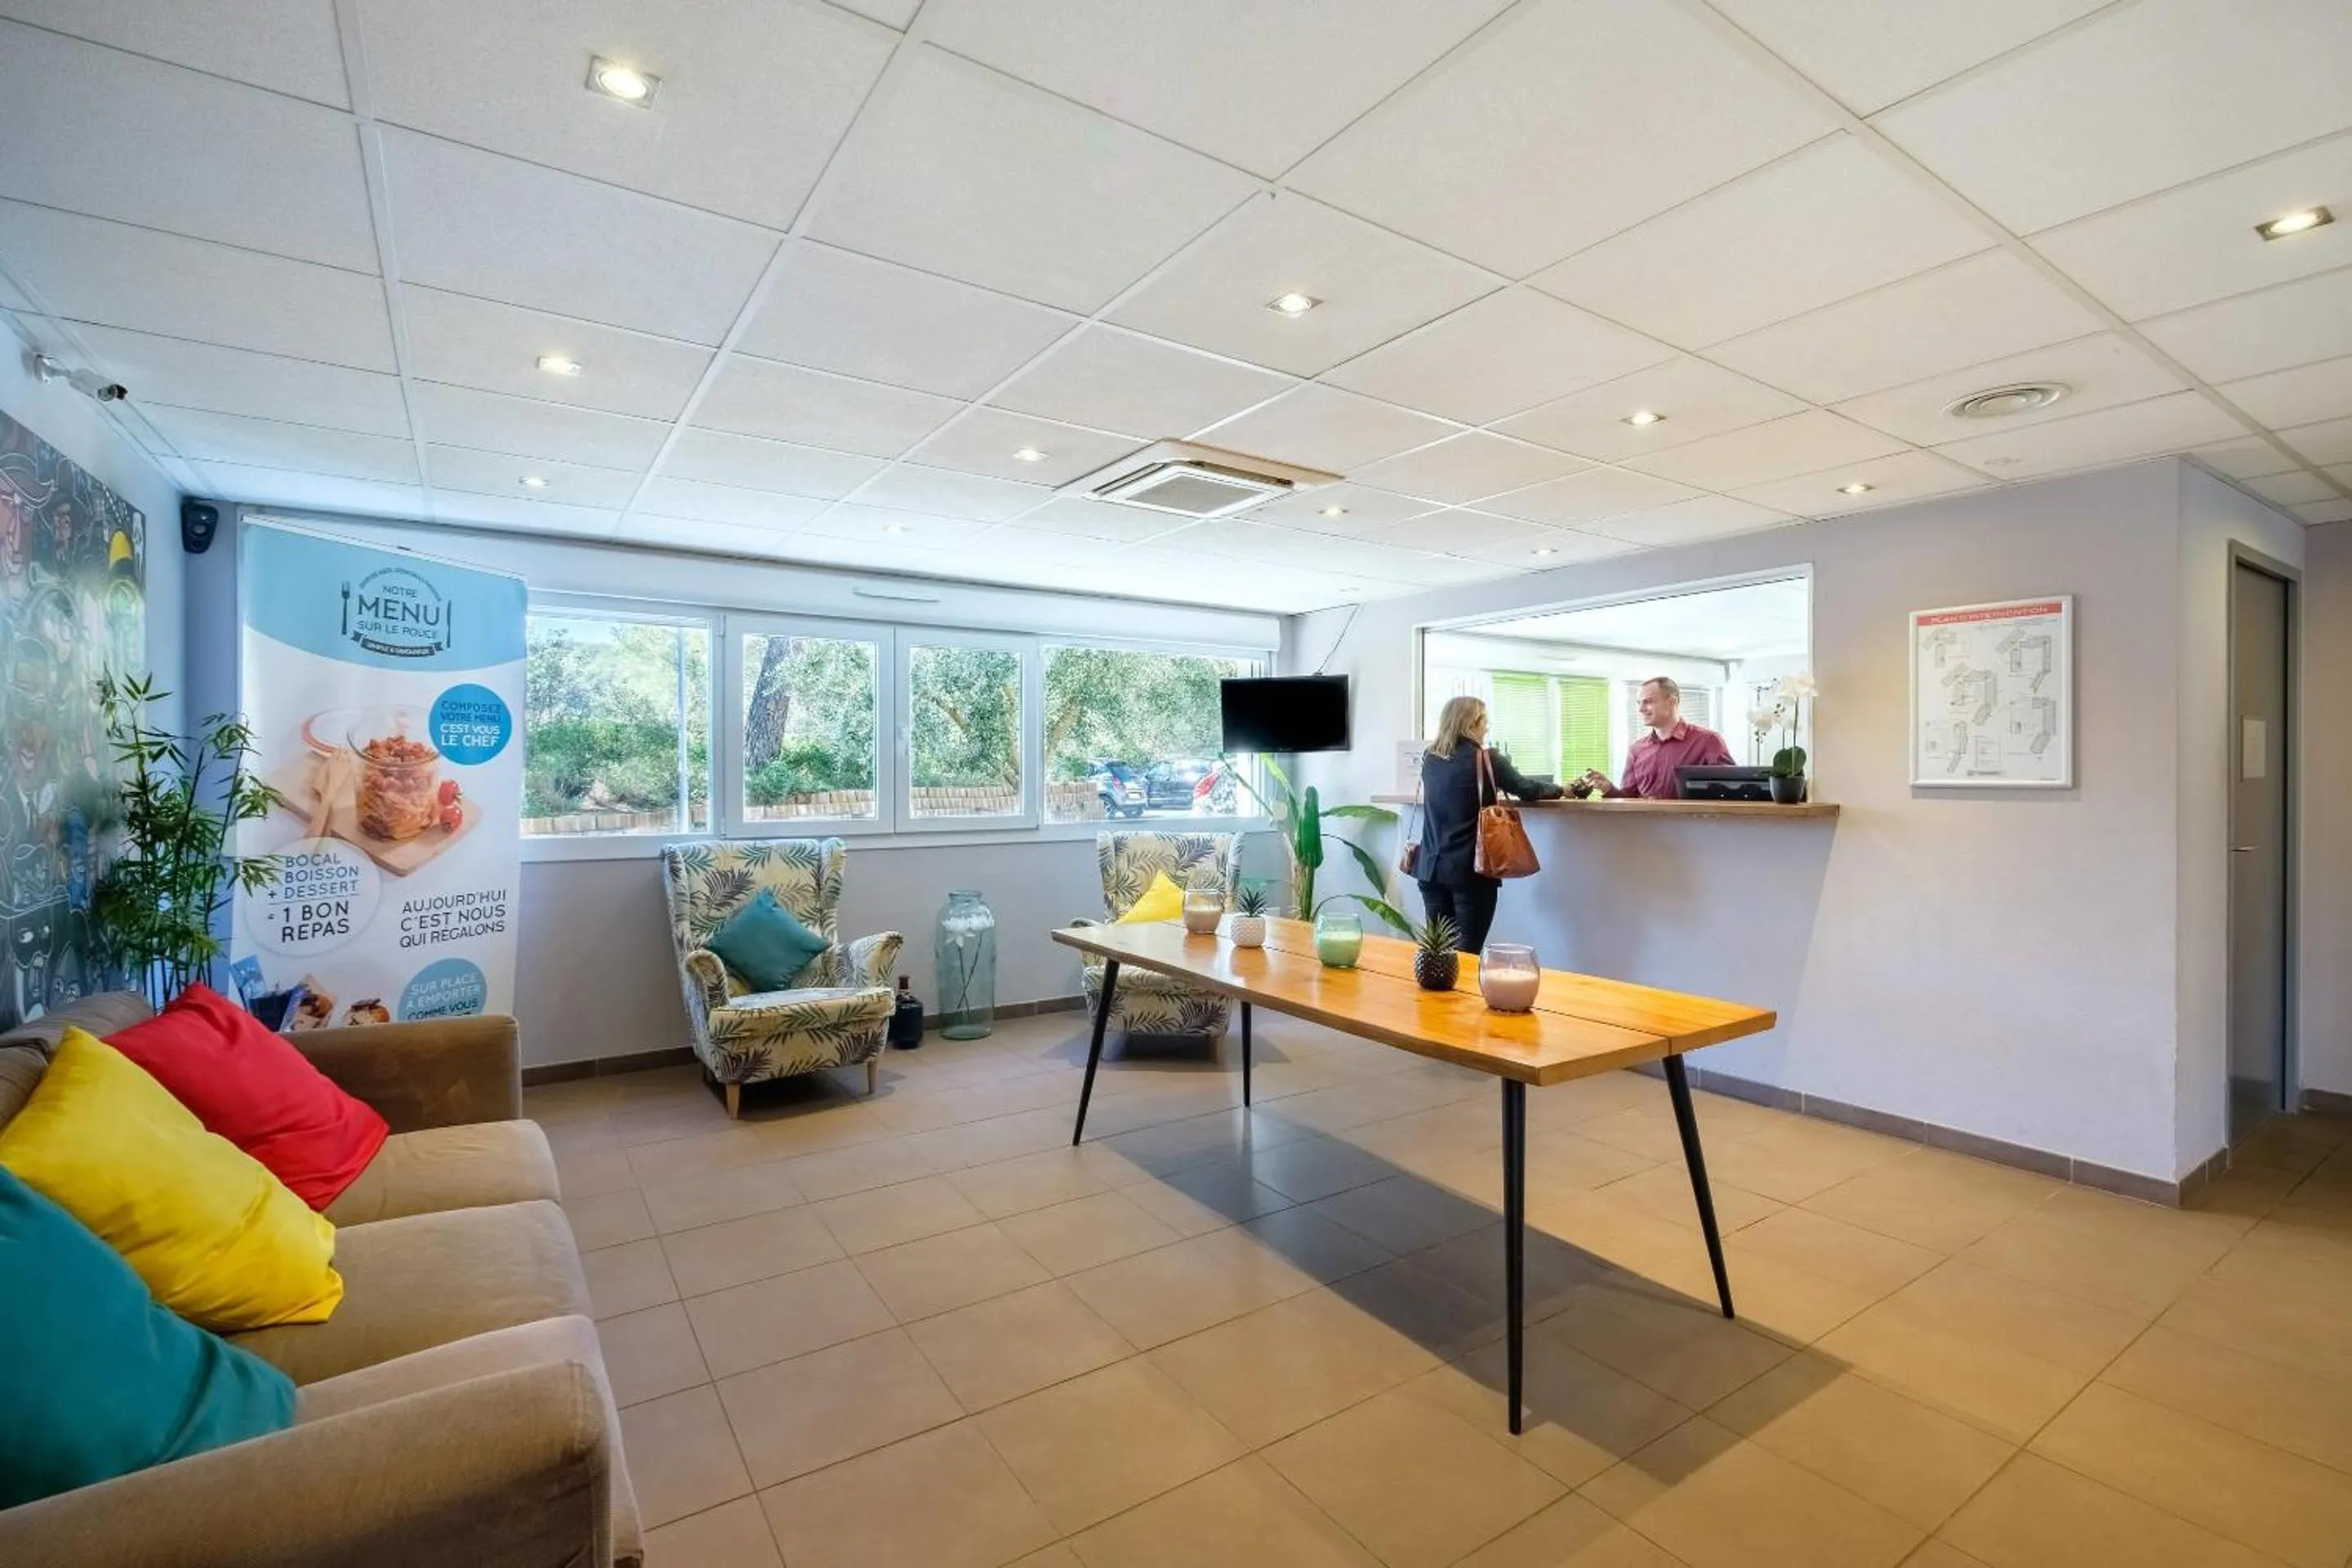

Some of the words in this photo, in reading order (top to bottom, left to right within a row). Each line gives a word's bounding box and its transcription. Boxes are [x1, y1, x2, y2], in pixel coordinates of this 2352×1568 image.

[358, 594, 440, 626] MENU
[357, 621, 381, 631] SUR
[385, 625, 399, 635] LE
[441, 701, 501, 714] COMPOSEZ
[471, 725, 501, 736] VOUS
[441, 735, 458, 746] LE
[462, 735, 501, 747] CHEF
[285, 853, 341, 868] BOCAL
[284, 866, 359, 884] BOISSON
[284, 880, 360, 899] DESSERT
[402, 889, 507, 915] AUJOURD'HUI
[283, 906, 290, 923] 1
[301, 900, 350, 921] BON
[400, 911, 452, 932] C'EST
[458, 904, 506, 924] NOUS
[282, 918, 350, 943] REPAS
[399, 933, 426, 949] QUI
[411, 980, 437, 996] SUR
[449, 999, 479, 1012] VOUS
